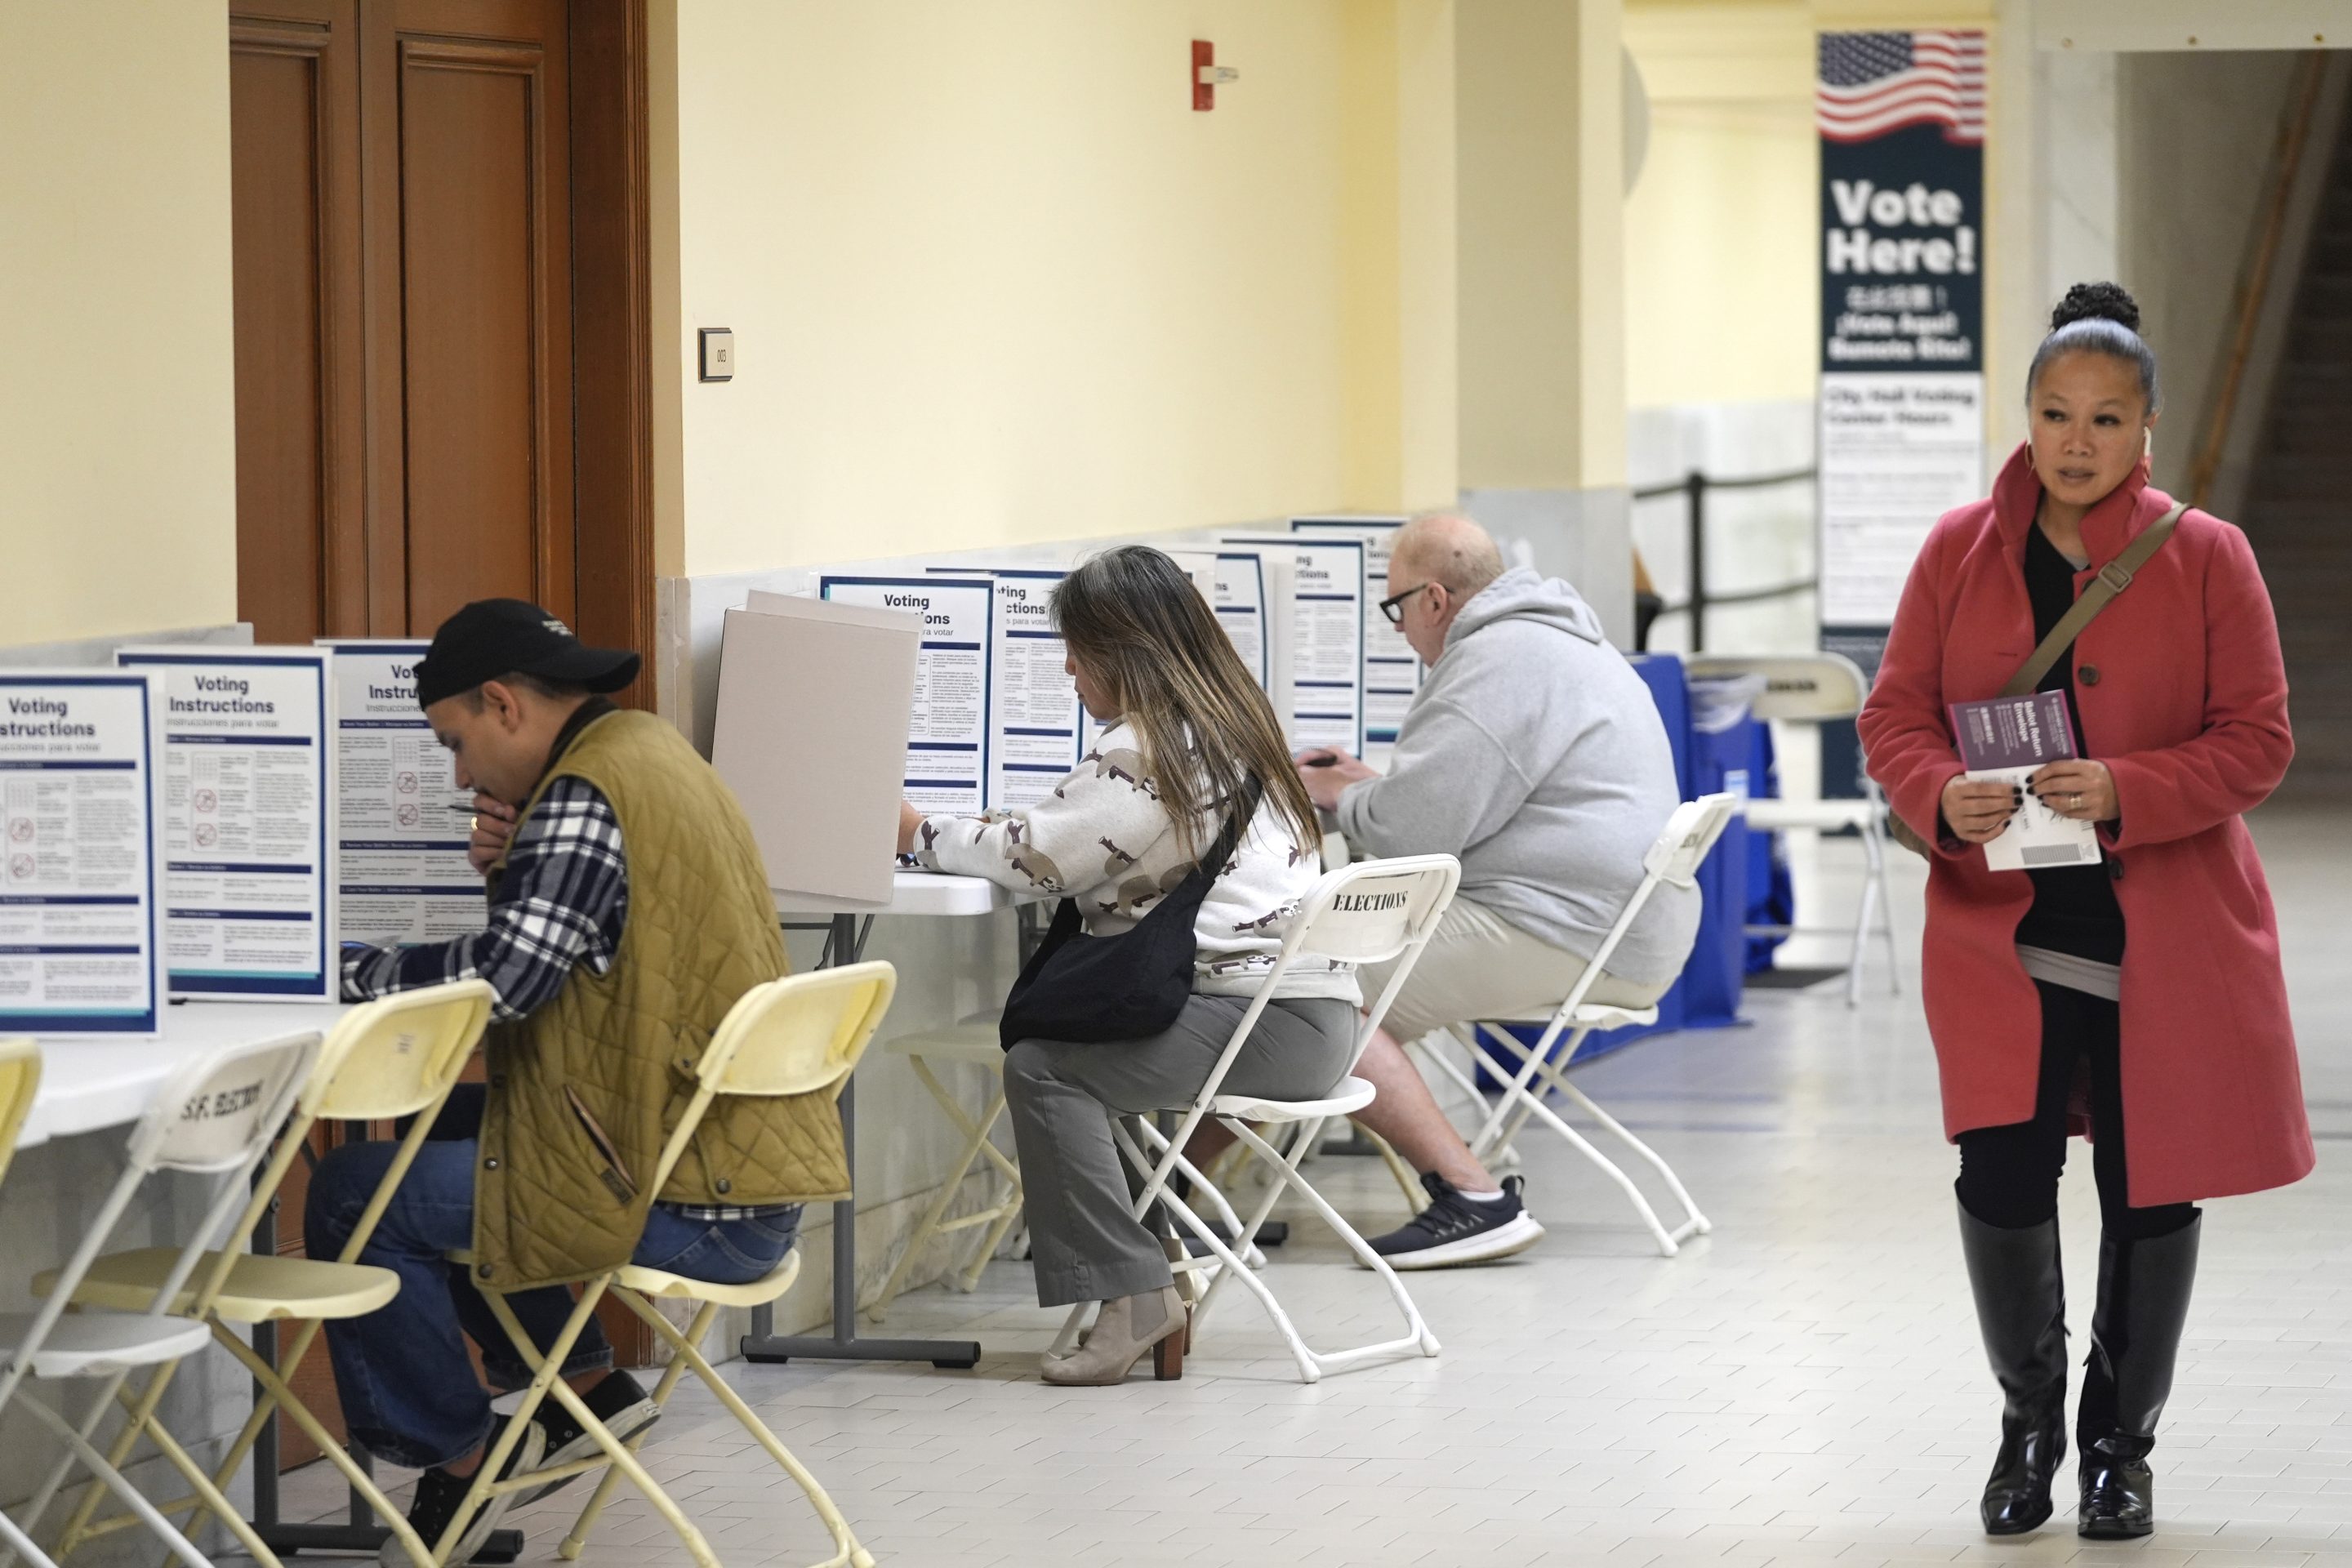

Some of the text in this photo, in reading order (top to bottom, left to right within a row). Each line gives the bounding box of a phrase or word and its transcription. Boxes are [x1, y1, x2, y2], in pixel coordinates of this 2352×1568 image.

[1830, 179, 1962, 227] Vote
[1827, 225, 1976, 275] Here!
[884, 594, 929, 609] Voting
[1000, 586, 1027, 600] ting
[933, 628, 954, 636] votar
[195, 675, 248, 695] Voting
[369, 685, 418, 699] Instru
[9, 697, 68, 718] Voting
[170, 697, 274, 713] Instructions
[0, 719, 96, 737] structions
[2013, 702, 2029, 743] Envelope
[2025, 701, 2042, 758] Ballot Return
[1333, 890, 1408, 911] ELECTIONS
